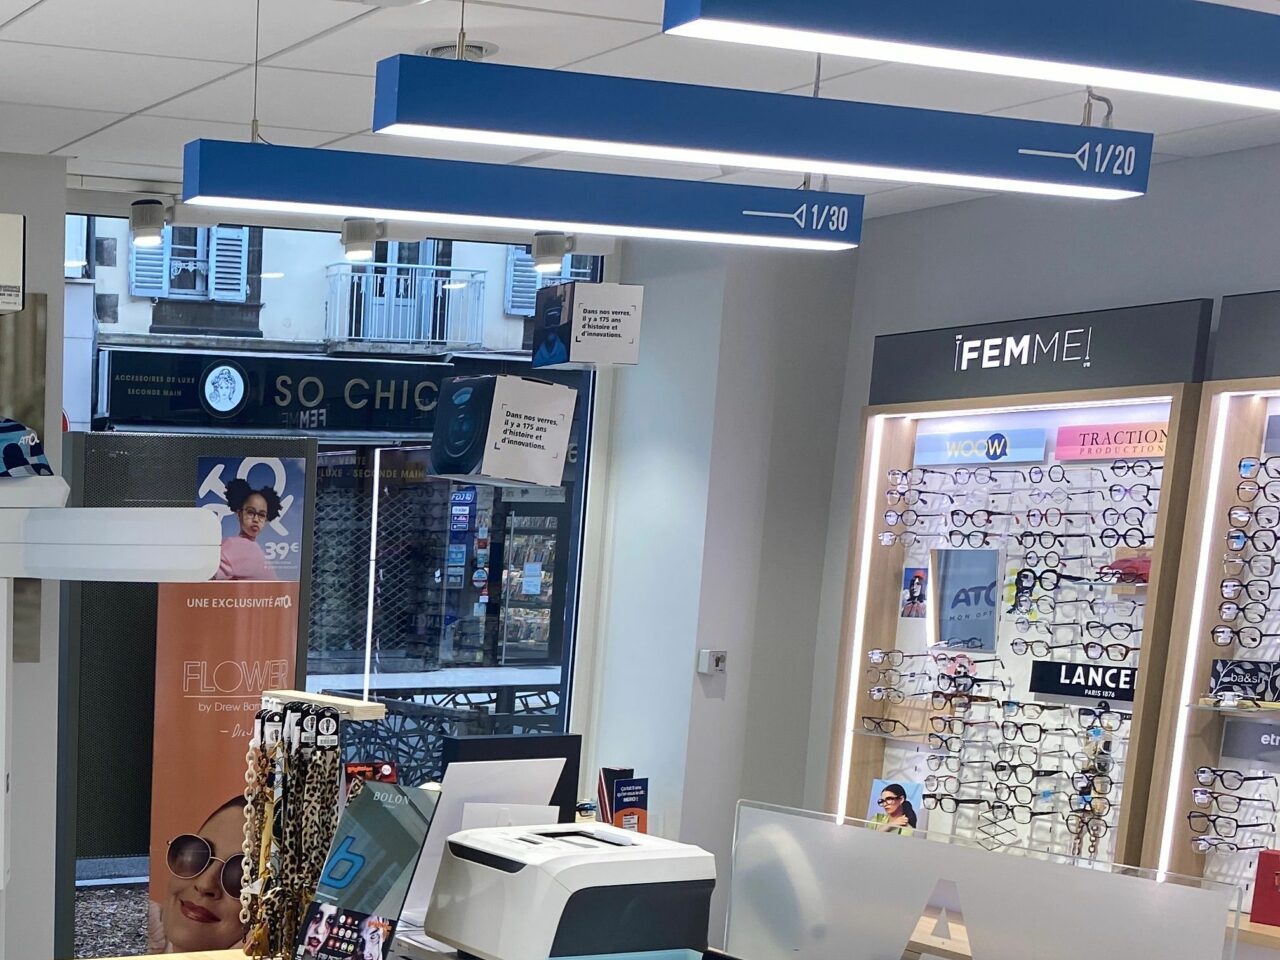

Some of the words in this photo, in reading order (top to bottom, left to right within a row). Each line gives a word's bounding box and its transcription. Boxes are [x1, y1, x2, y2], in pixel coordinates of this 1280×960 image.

[1094, 142, 1136, 176] 1/20
[811, 202, 848, 231] 1/30
[128, 388, 160, 396] SECONDE
[163, 389, 182, 397] MAIN
[274, 375, 324, 408] SO
[344, 378, 439, 412] CHIC
[506, 410, 522, 420] Dans
[524, 413, 536, 422] nos
[537, 416, 558, 427] verres,
[510, 421, 515, 429] y
[523, 423, 534, 431] 175
[536, 425, 547, 433] ans
[503, 429, 533, 440] d'histoire
[353, 469, 397, 479] SECNDE
[187, 598, 209, 608] UNE
[212, 595, 273, 608] EXCLUSIVITÉ
[183, 659, 289, 692] FLOWER
[1085, 689, 1102, 697] PARIS
[198, 702, 212, 713] by
[215, 702, 240, 712] Drew
[373, 791, 409, 805] BOLON
